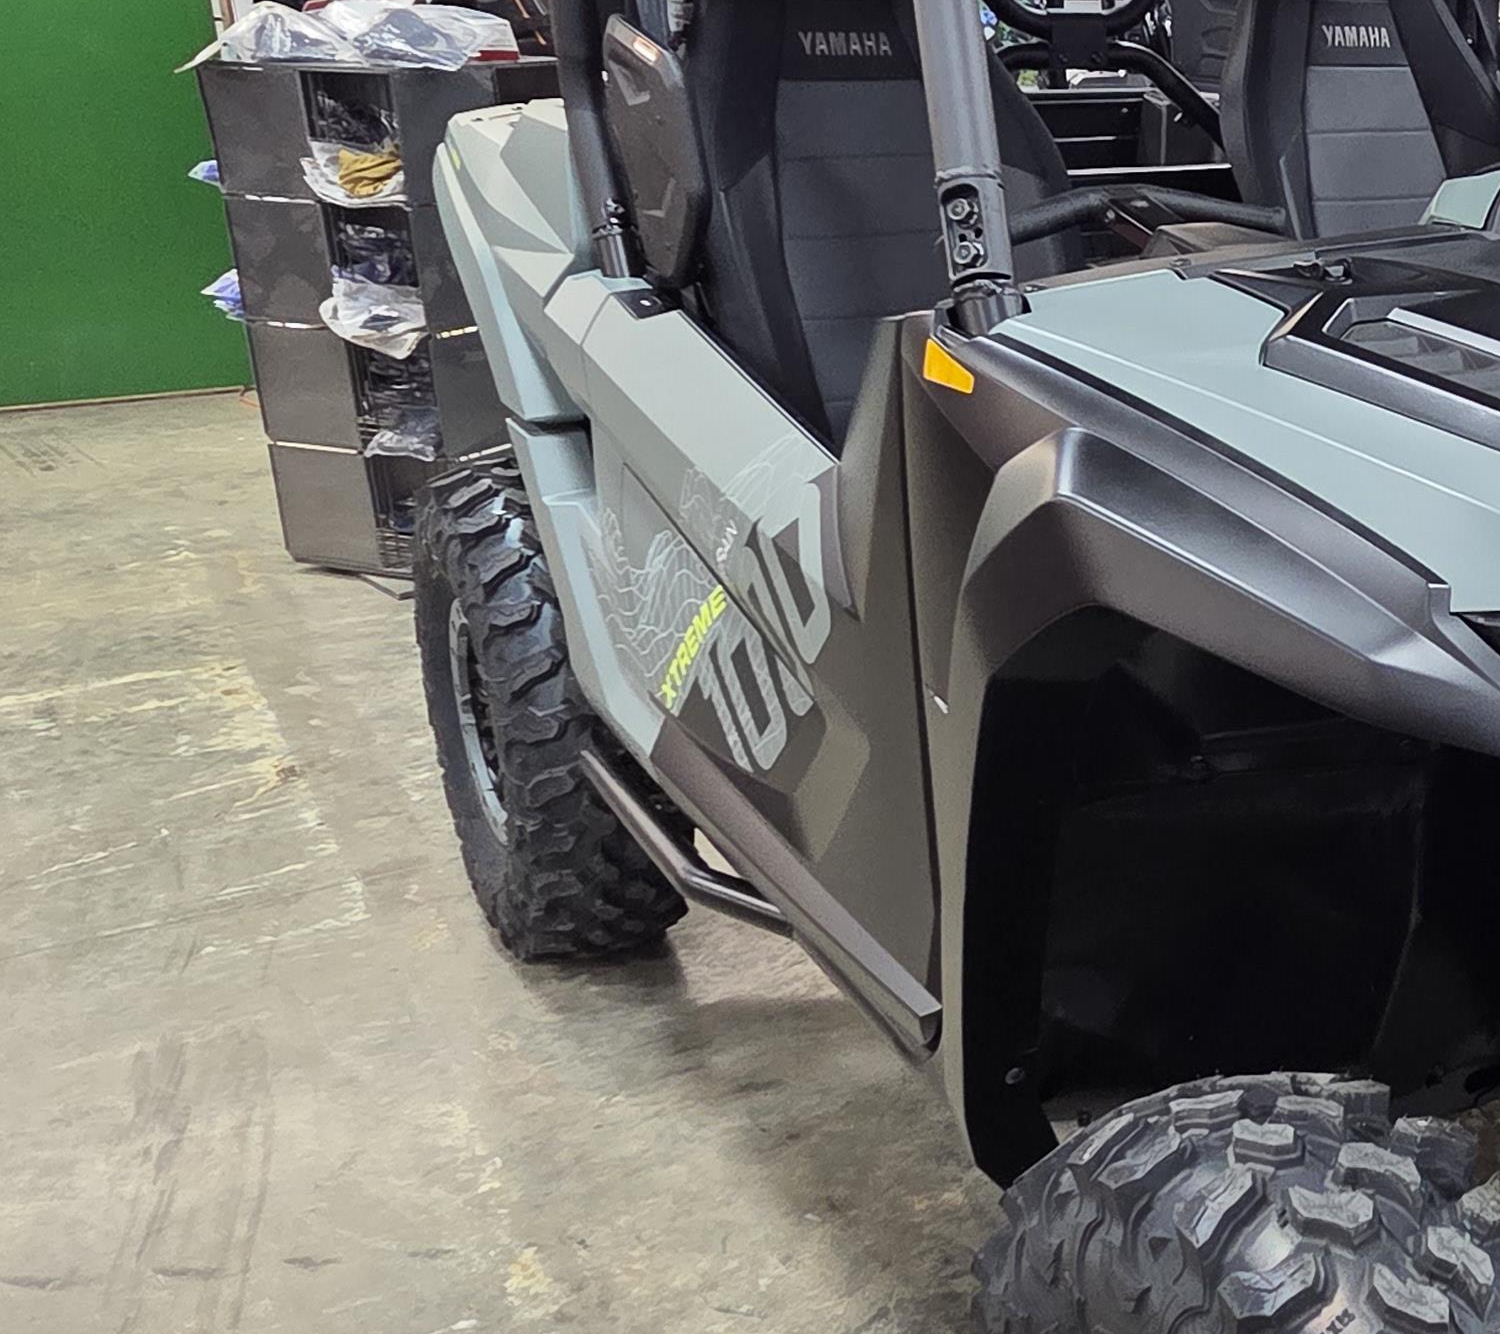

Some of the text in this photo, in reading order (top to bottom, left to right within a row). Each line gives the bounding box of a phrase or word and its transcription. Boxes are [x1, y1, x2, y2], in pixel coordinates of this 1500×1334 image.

[798, 30, 892, 56] YAMAHA
[1321, 24, 1391, 48] YAMAHA
[661, 584, 728, 711] XTREME
